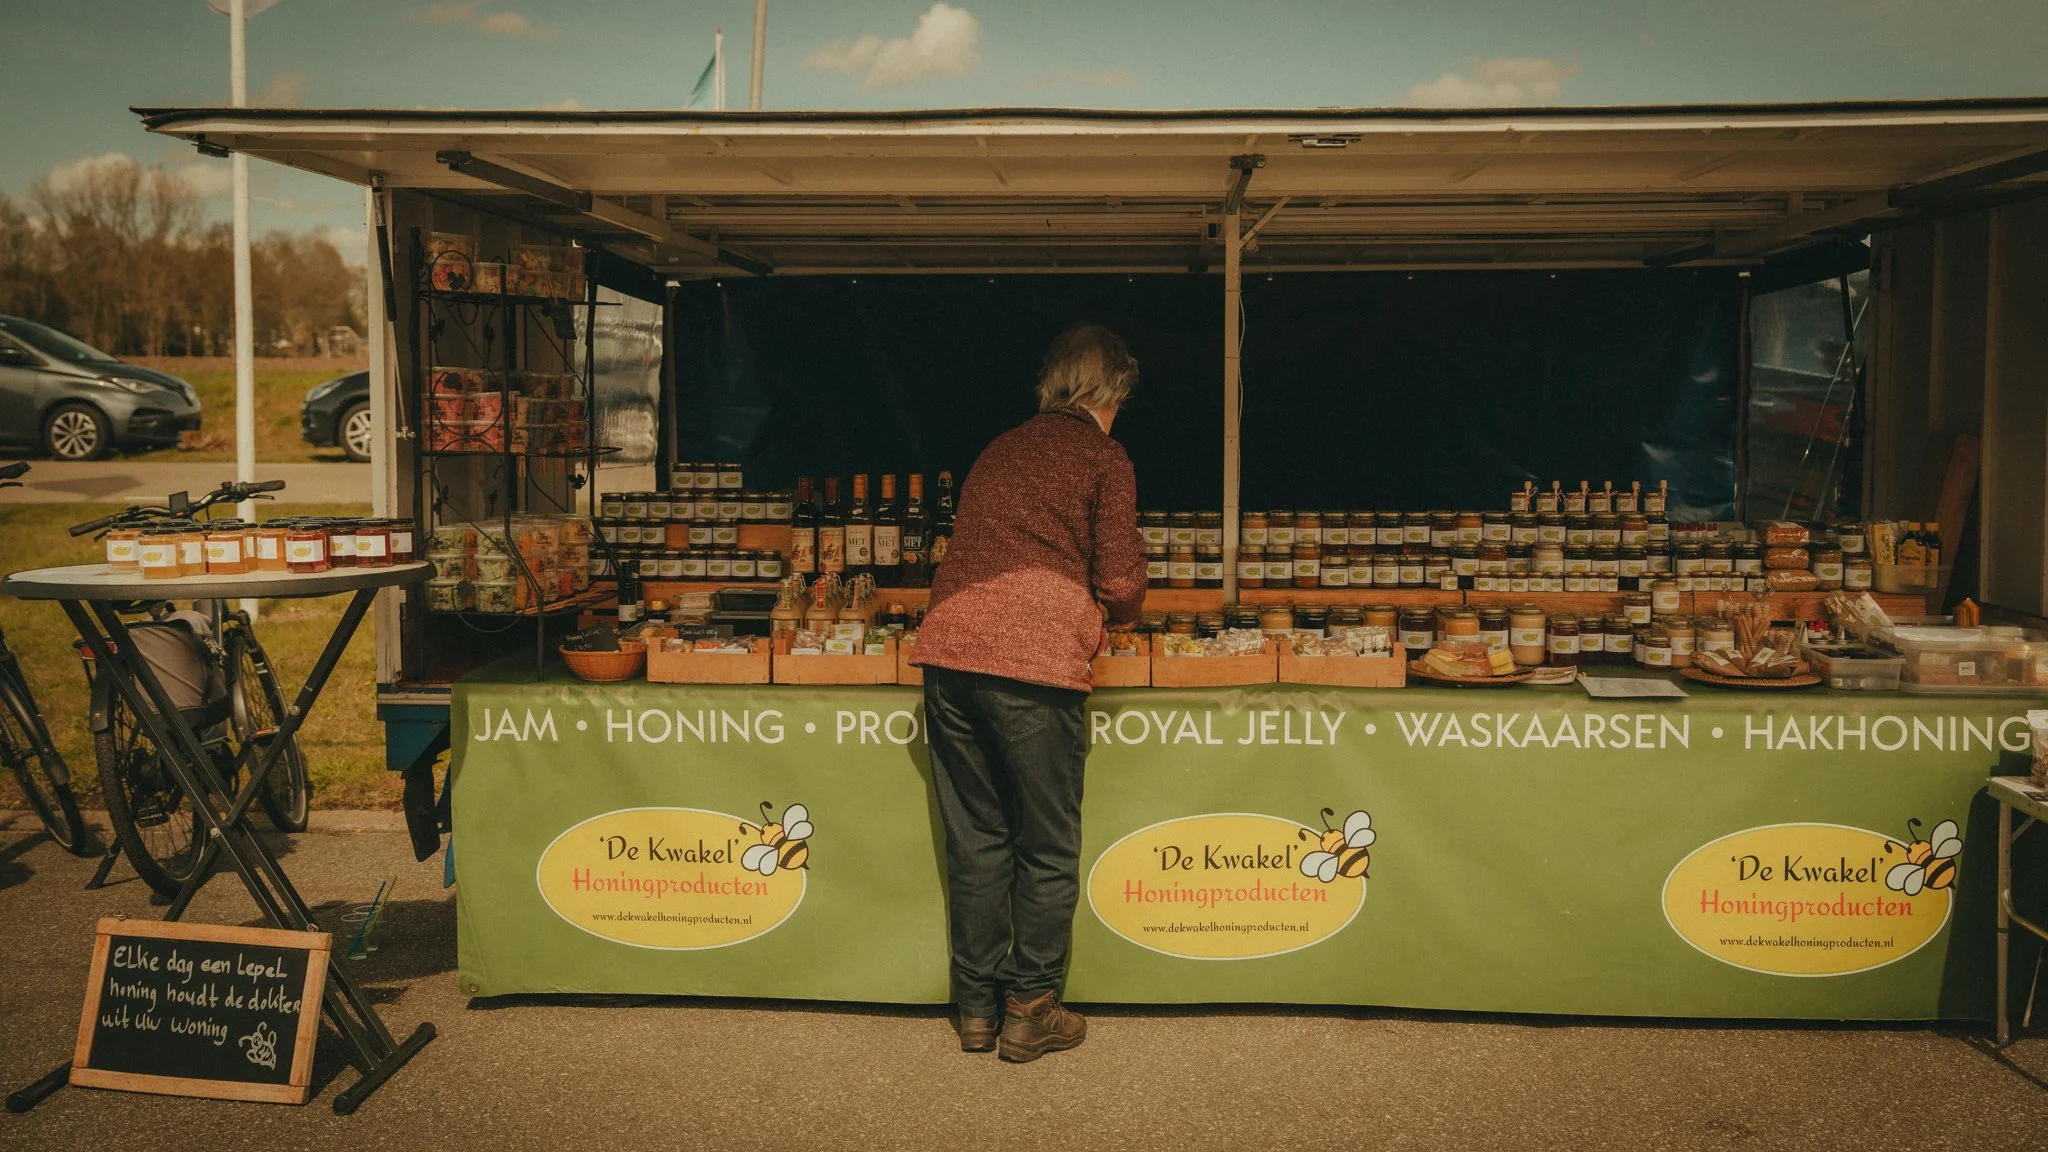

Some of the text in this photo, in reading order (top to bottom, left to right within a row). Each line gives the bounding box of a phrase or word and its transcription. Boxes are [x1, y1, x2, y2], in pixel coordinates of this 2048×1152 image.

[474, 708, 929, 745] JAM HONING PRO
[1091, 710, 2030, 752] ROYAL JELLY WASKAARSEN HAKHONING
[572, 867, 769, 899] Honingproducten
[1124, 878, 1328, 909] Honingproducten
[592, 911, 752, 926] www.dekwakelhoningproducten.nl
[1700, 888, 1914, 923] Honingproducten
[1142, 921, 1310, 935] www.dekwakelhoningproducten.nl
[1719, 935, 1894, 951] www.dekwakelhoningproducten.nl
[166, 949, 194, 984] dag
[200, 959, 231, 974] een
[109, 977, 157, 1013] honing
[167, 982, 219, 1008] houdt
[224, 984, 244, 1009] de
[101, 1004, 130, 1029] uit
